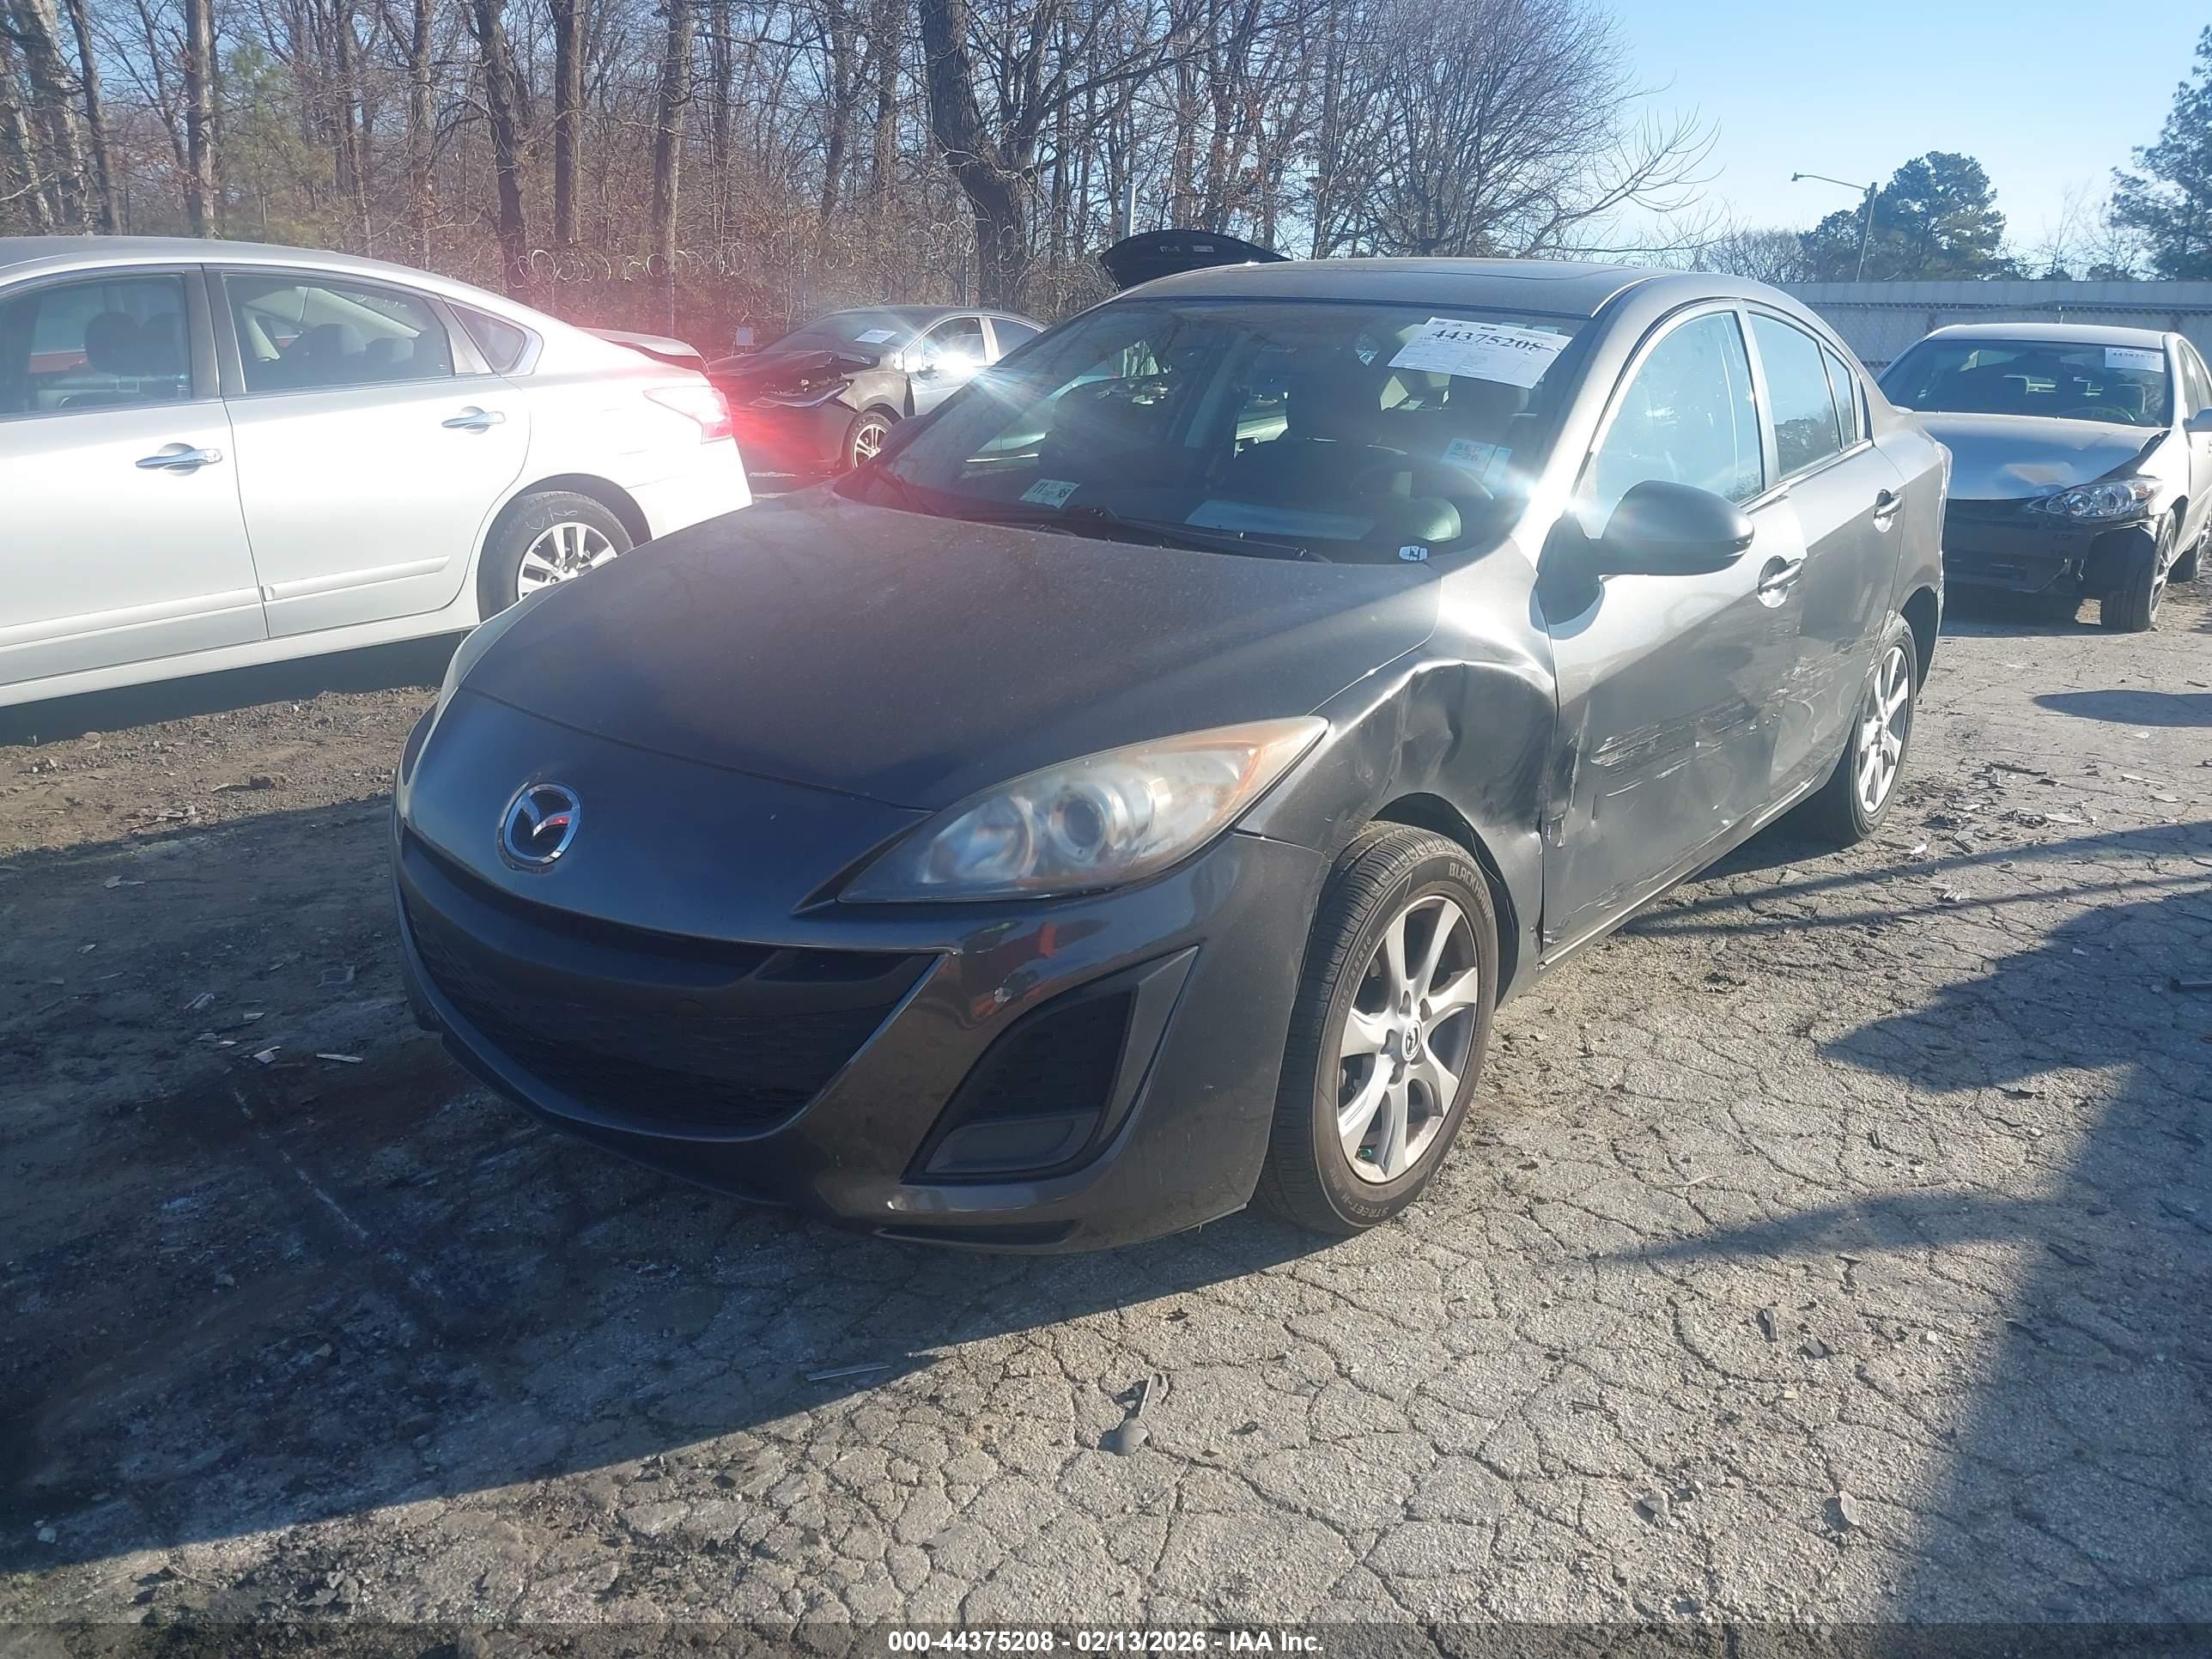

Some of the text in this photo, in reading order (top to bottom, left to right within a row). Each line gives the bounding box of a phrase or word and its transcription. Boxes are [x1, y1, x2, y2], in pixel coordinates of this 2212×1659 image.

[1431, 329, 1545, 351] 44375208
[1455, 441, 1484, 453] SEP
[1449, 861, 1493, 922] BLACKHAWK
